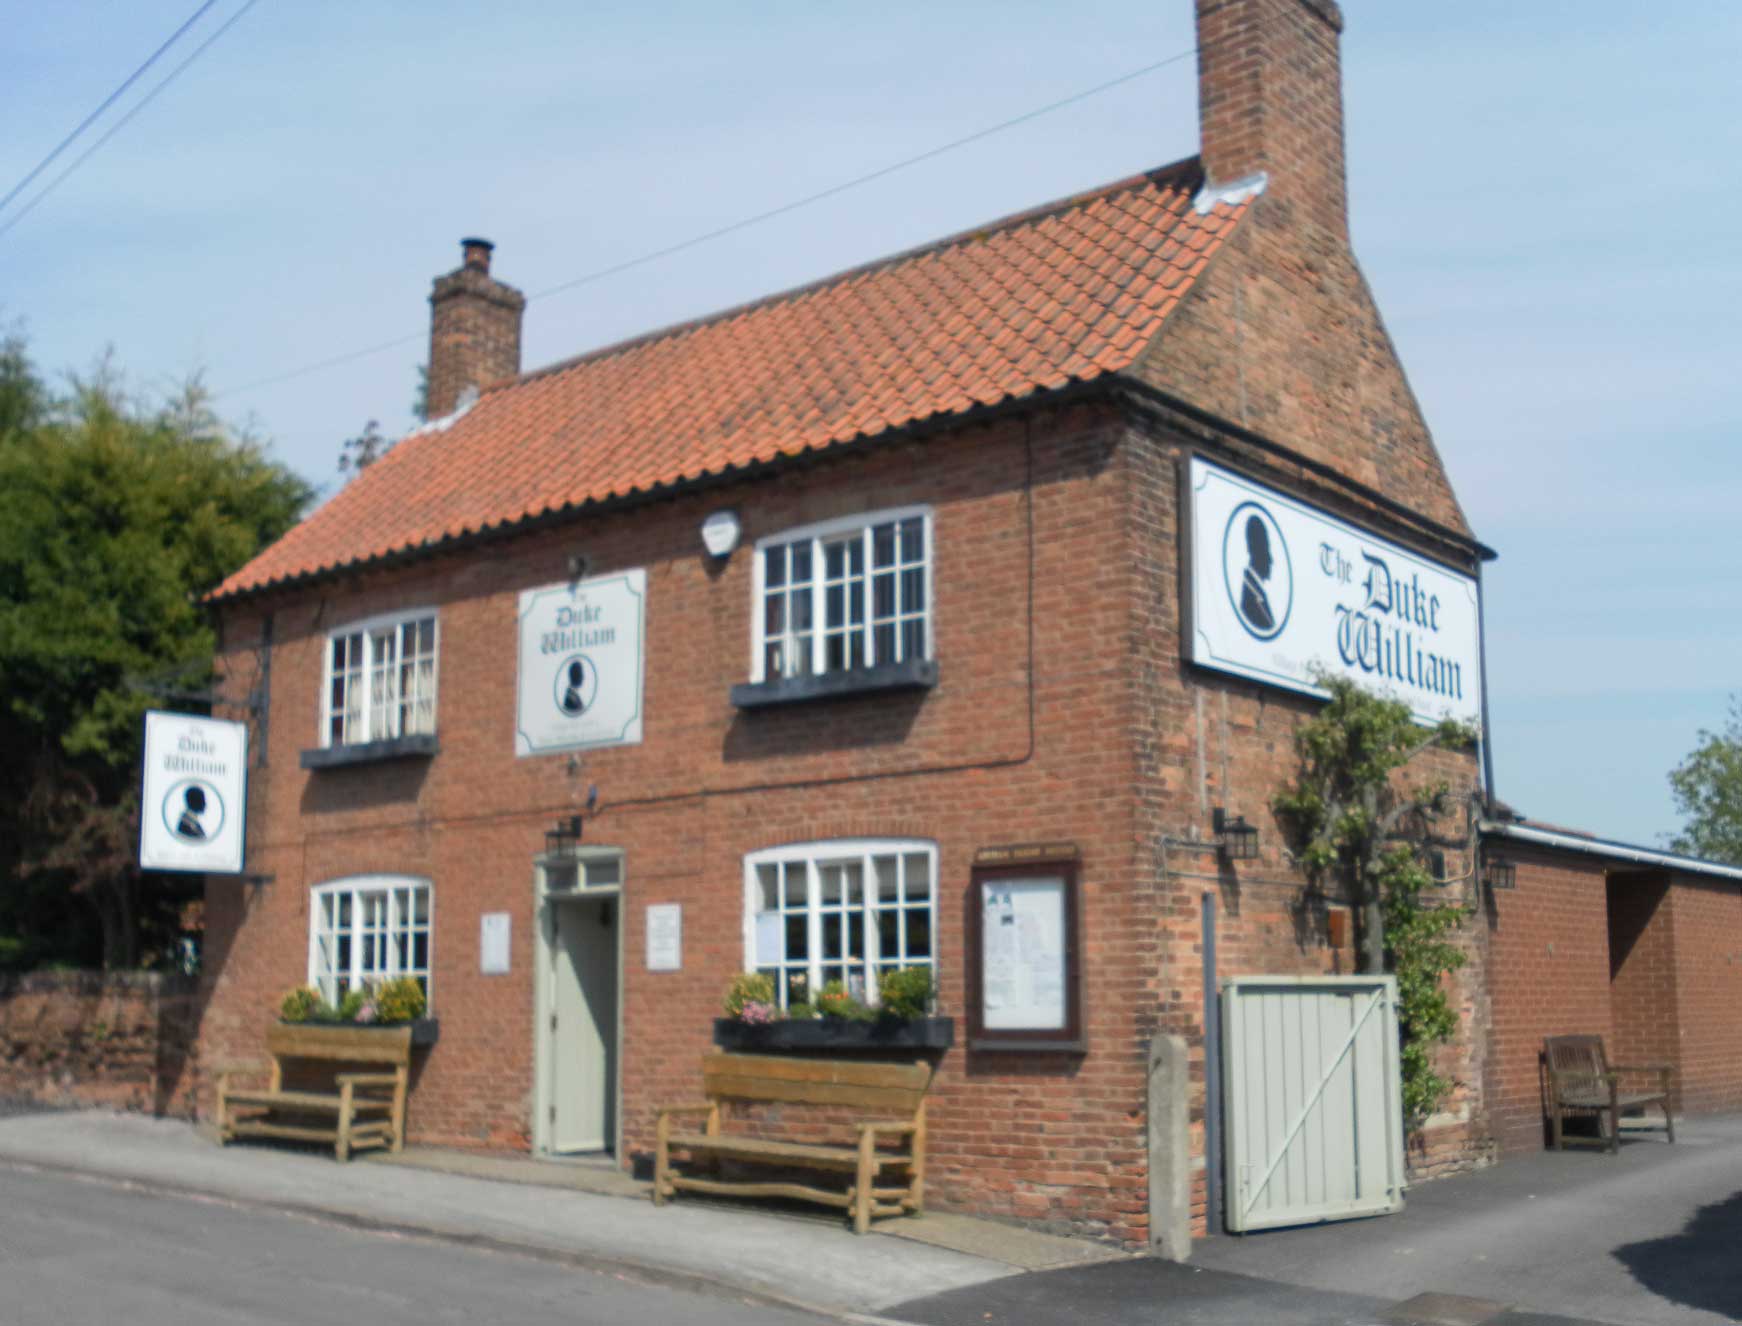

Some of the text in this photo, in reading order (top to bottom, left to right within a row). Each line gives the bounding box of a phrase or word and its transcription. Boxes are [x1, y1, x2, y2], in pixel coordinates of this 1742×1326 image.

[1320, 541, 1441, 633] The Duke
[556, 604, 603, 628] Duke
[541, 627, 616, 655] William
[1335, 602, 1463, 701] William
[164, 754, 227, 776] William
